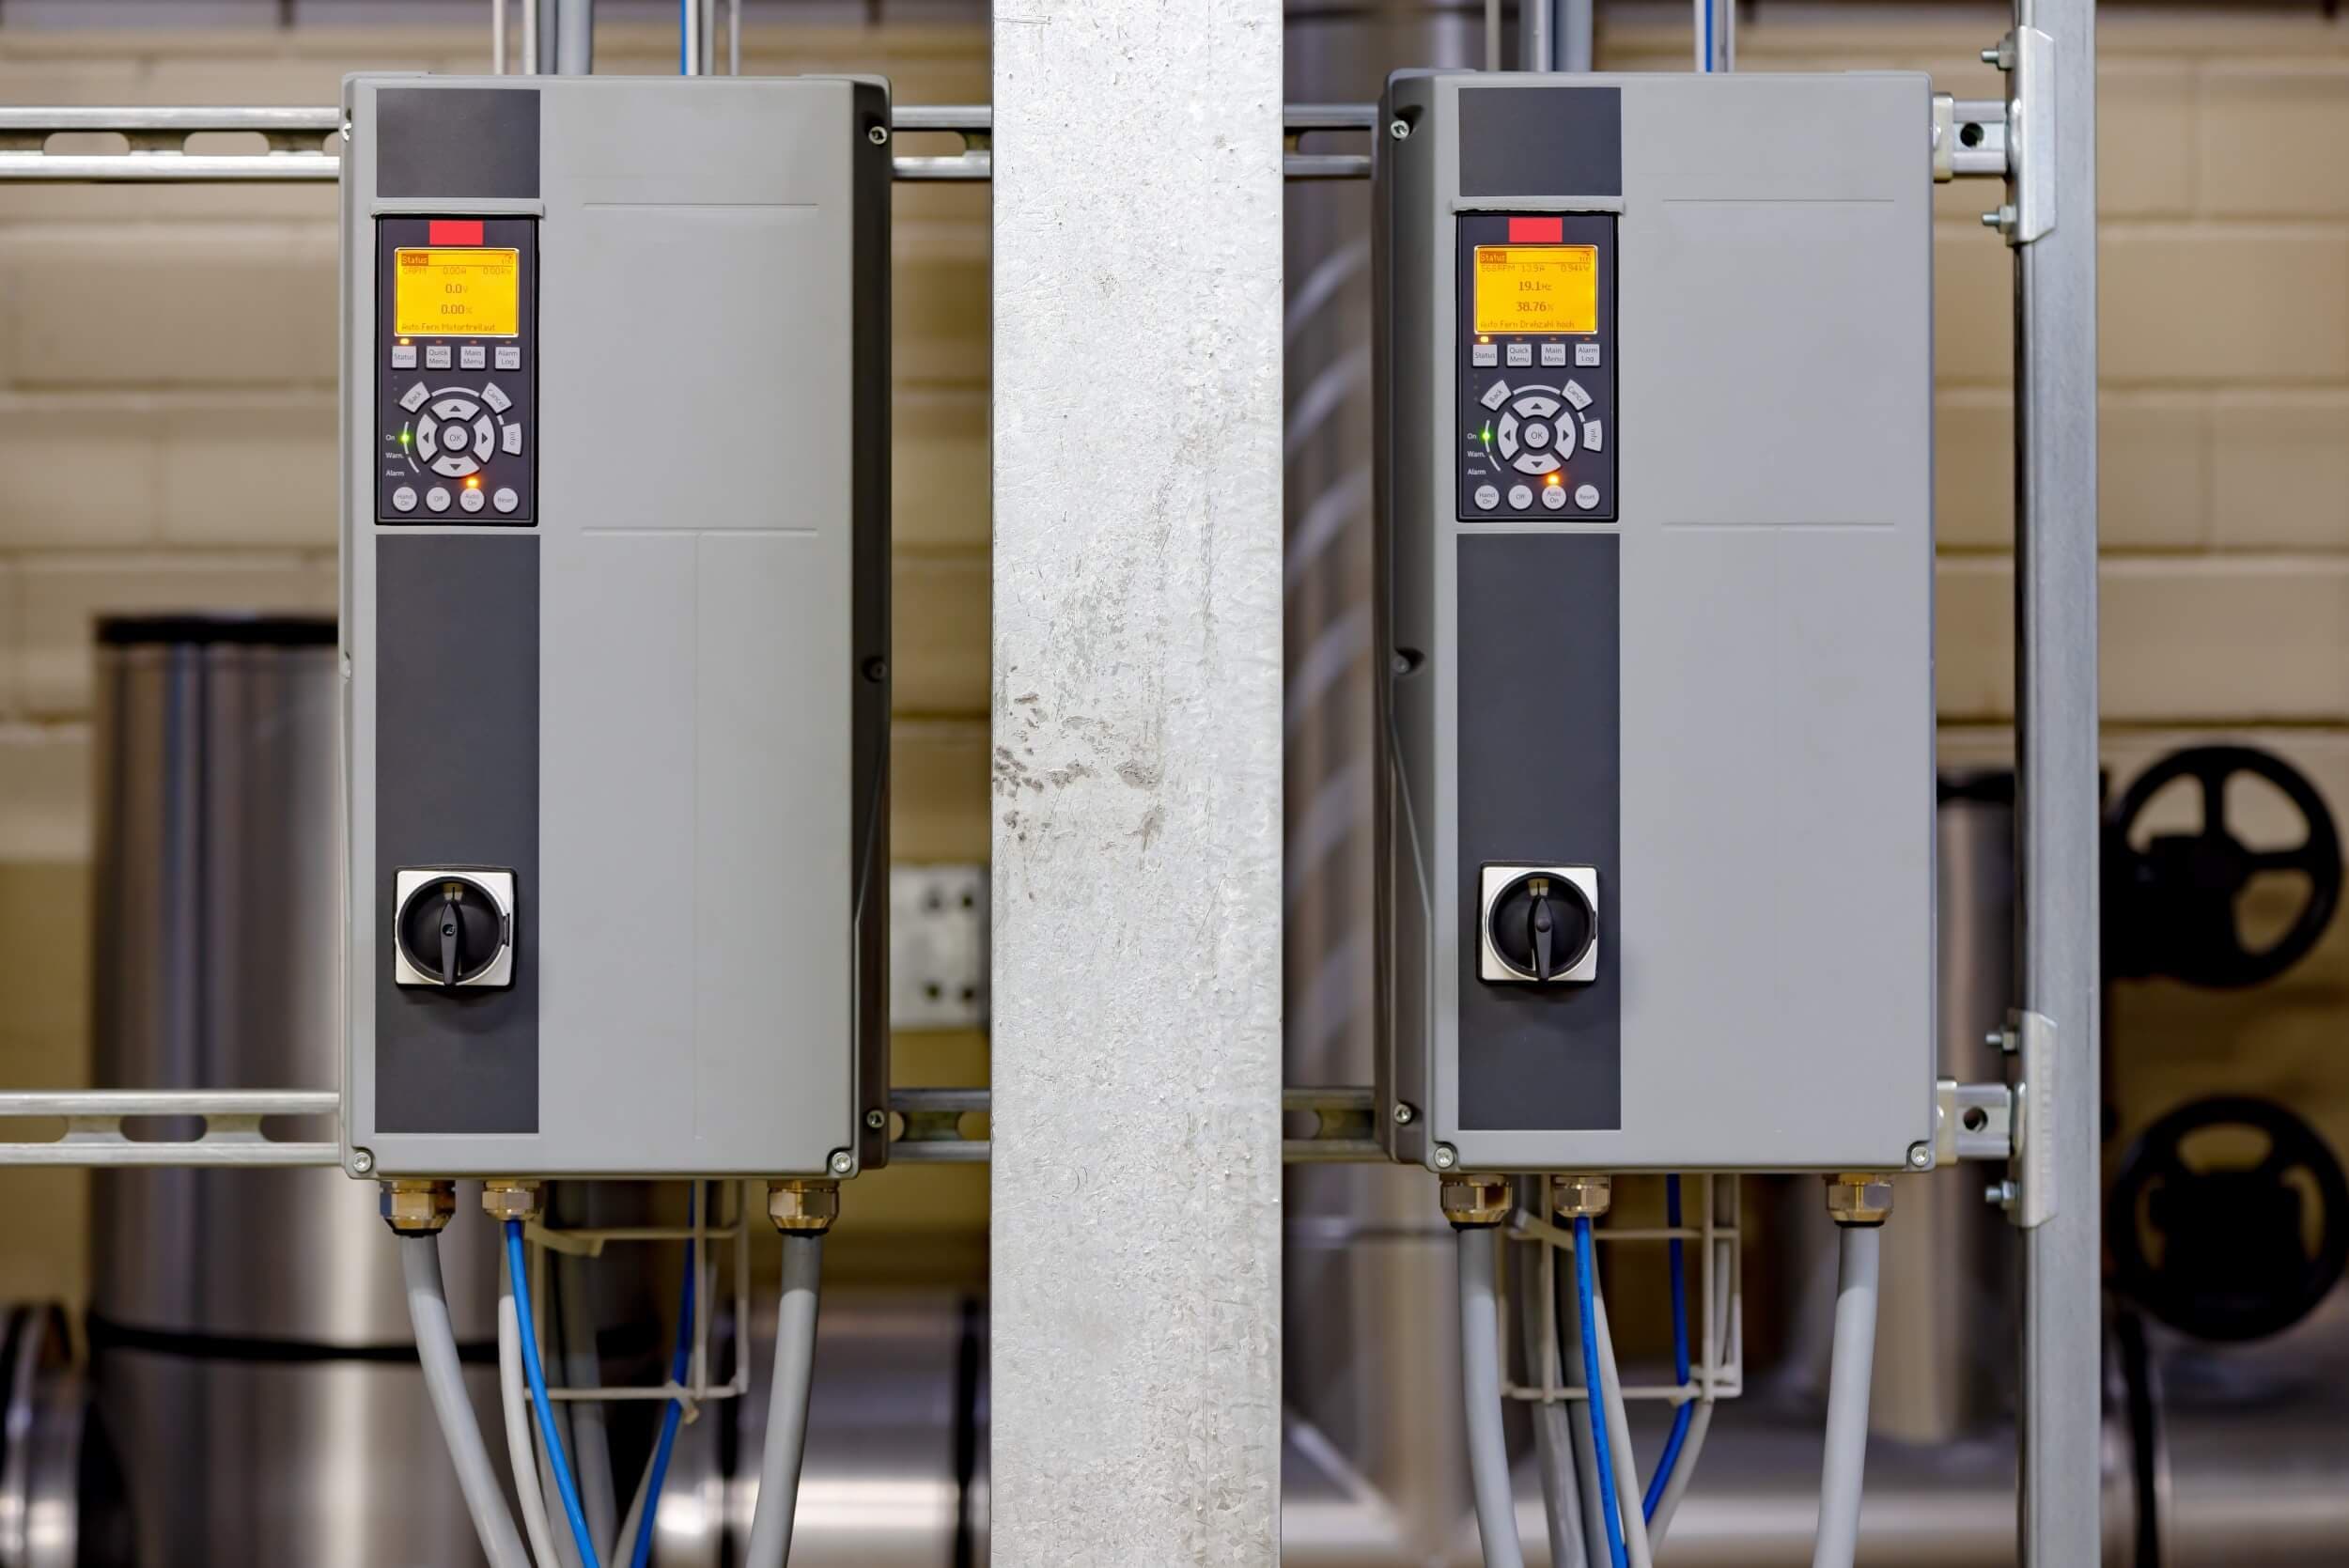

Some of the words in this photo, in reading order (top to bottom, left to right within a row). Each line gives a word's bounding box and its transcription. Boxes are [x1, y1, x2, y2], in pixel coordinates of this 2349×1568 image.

[1480, 253, 1506, 262] Status
[501, 358, 514, 366] Log
[450, 434, 461, 442] OK
[1531, 431, 1543, 440] OK
